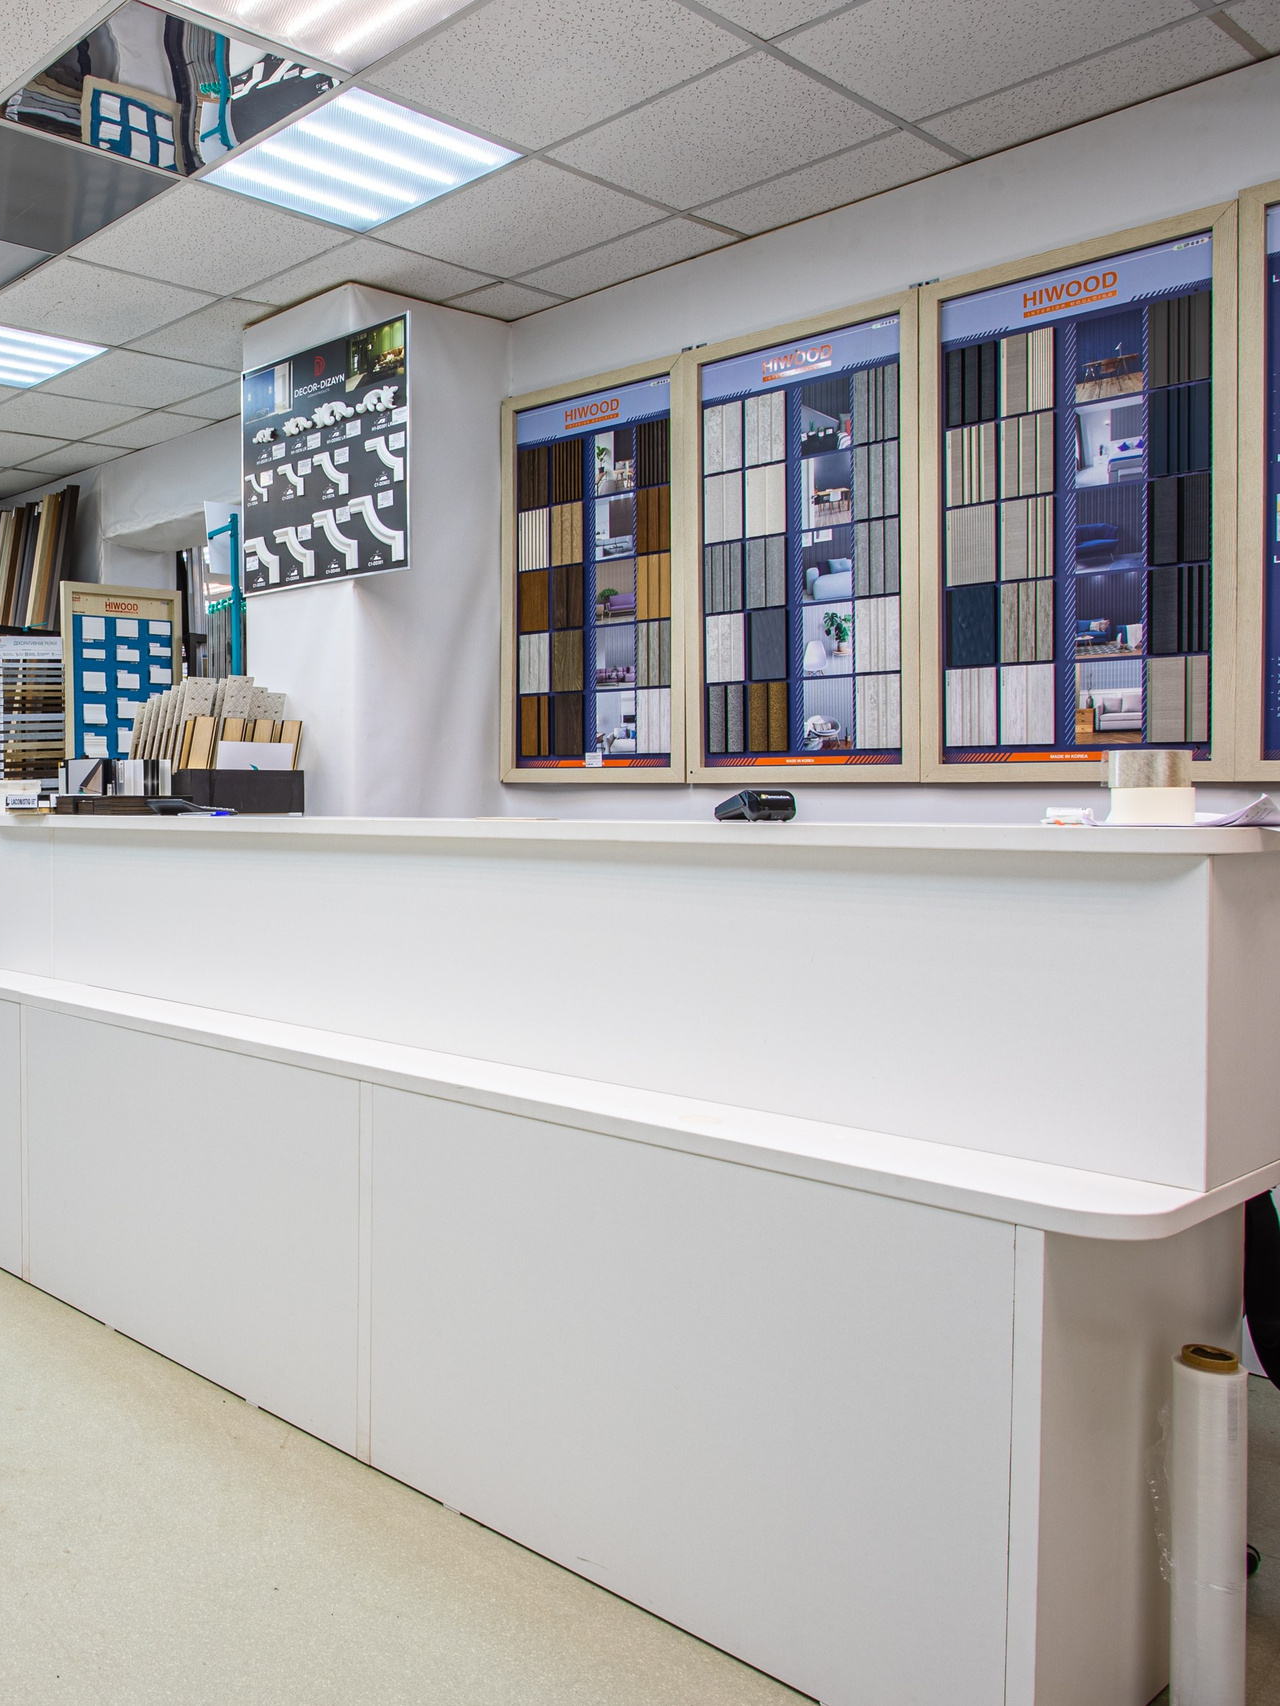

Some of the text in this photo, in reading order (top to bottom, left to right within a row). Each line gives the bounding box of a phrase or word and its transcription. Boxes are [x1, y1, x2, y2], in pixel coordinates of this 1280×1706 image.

[1023, 271, 1118, 309] HIWOOD
[1027, 293, 1113, 317] INTERIOR MOULDING
[762, 343, 833, 374] HIWOOD
[293, 373, 345, 398] DECOR-DIZAYN
[564, 398, 620, 422] HIWOOD
[105, 601, 138, 611] HIWOOD
